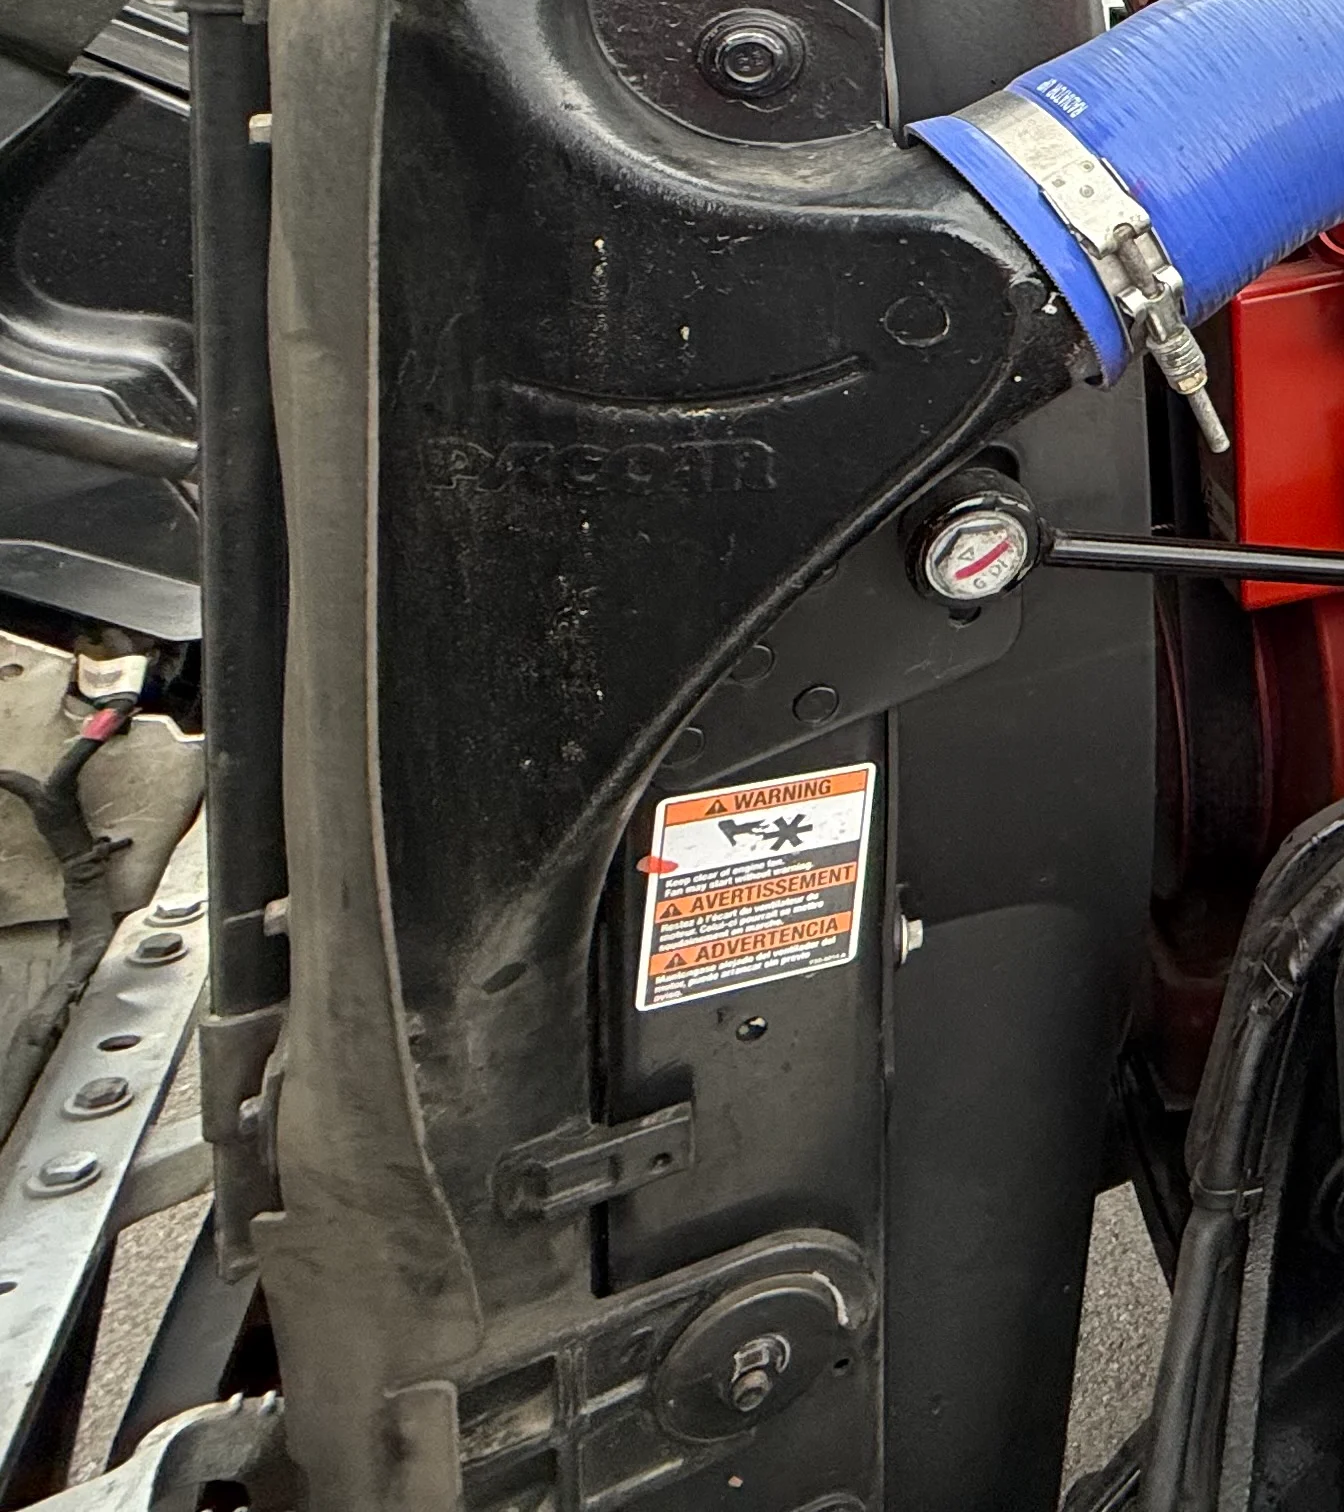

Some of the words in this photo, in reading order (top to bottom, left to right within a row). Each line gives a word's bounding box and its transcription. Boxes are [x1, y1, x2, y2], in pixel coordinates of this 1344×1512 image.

[734, 779, 832, 811] WARNING
[690, 865, 853, 913] AVERTISSEMENT
[694, 917, 839, 963] ADVERTENCIA
